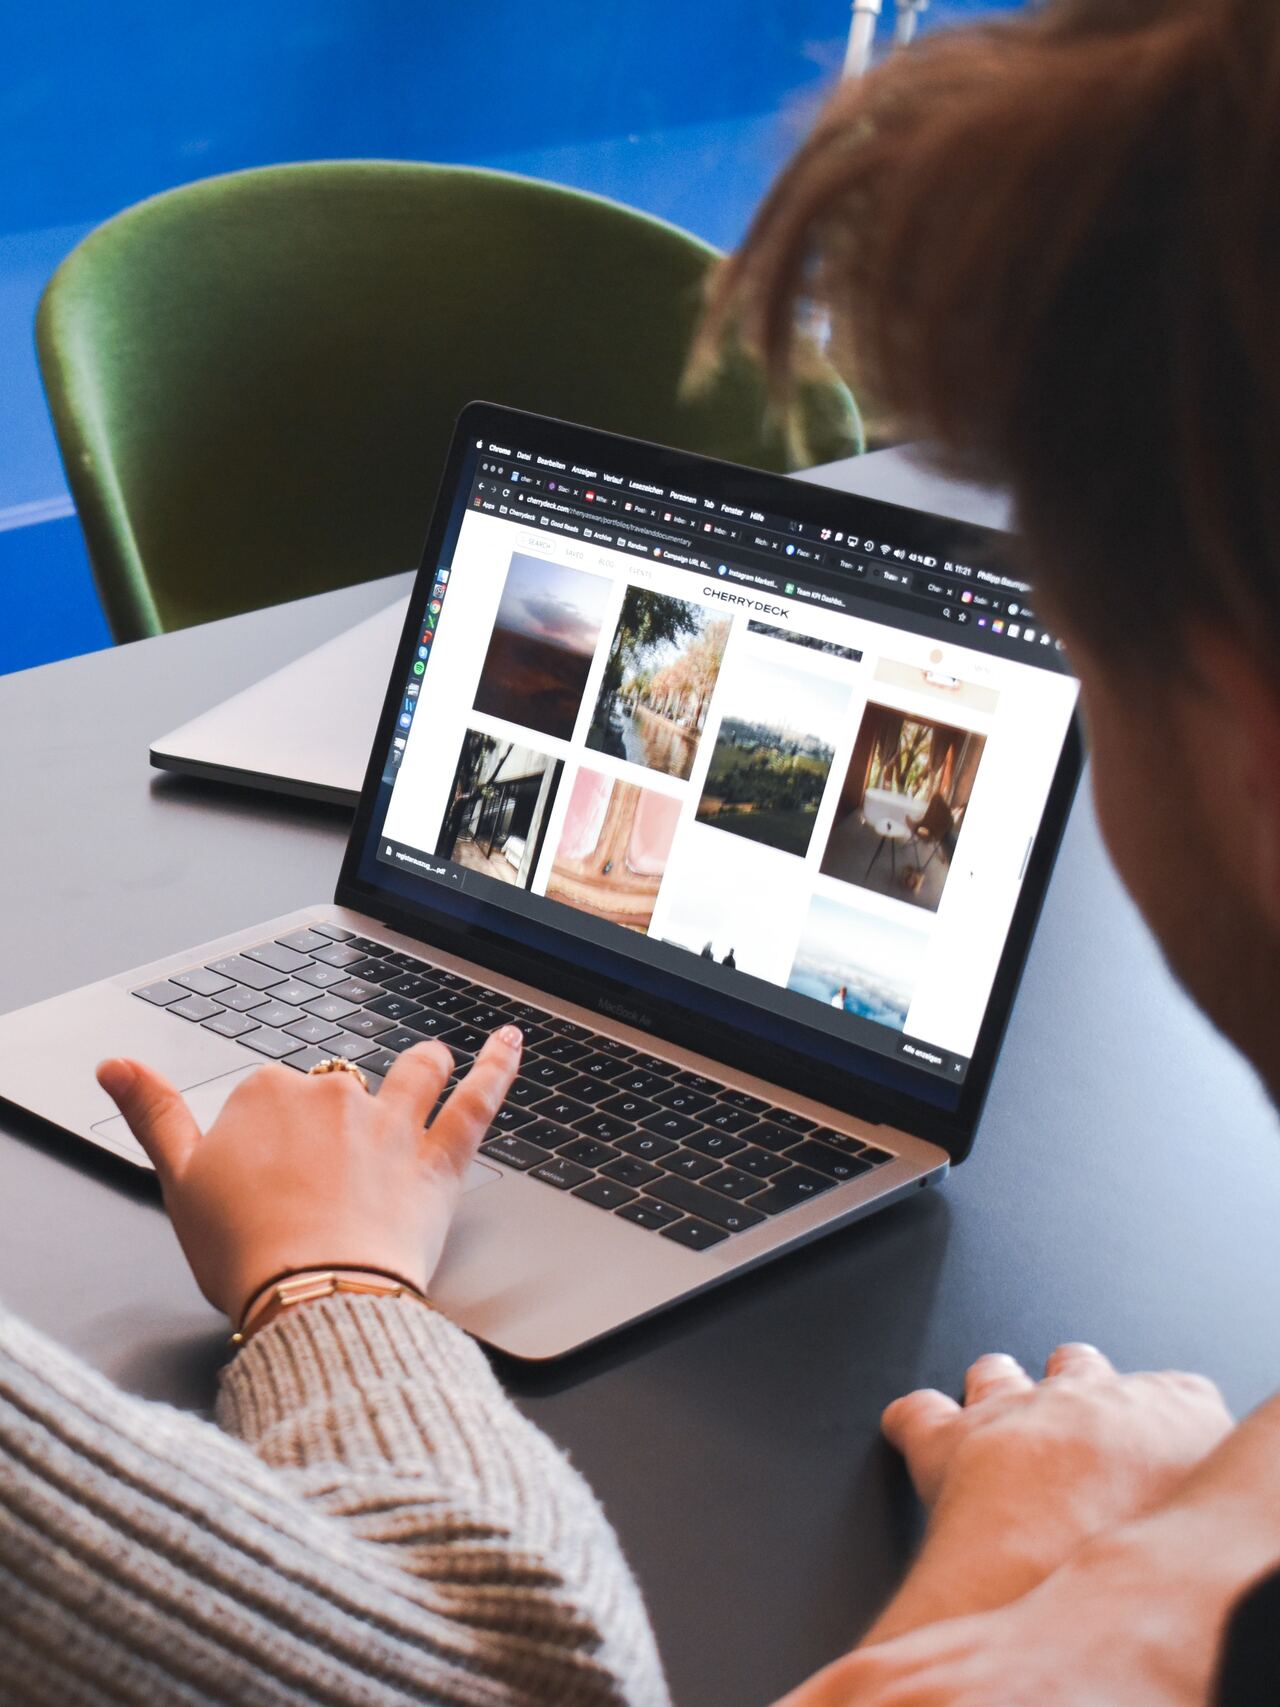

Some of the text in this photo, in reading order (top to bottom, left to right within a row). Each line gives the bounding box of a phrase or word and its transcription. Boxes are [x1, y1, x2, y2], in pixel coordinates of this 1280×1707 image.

[489, 444, 765, 522] Chrome Datei Bearbeiten Anzeigen Verlauf Lesezeichen Personen Tab Fenster Hilfe
[482, 501, 495, 510] Apps
[508, 509, 536, 521] Cherrydeck
[550, 519, 579, 534] Good Reads
[594, 531, 612, 542] Archive
[627, 541, 648, 552] Random
[663, 550, 688, 564] Campaign
[728, 568, 755, 582] Instagram
[954, 564, 972, 576] 11:21
[796, 586, 811, 596] Team
[702, 586, 790, 619] CHERRYDECK
[425, 1018, 437, 1026] R
[903, 1044, 942, 1064] Alle anzeigen
[555, 1104, 568, 1112] K
